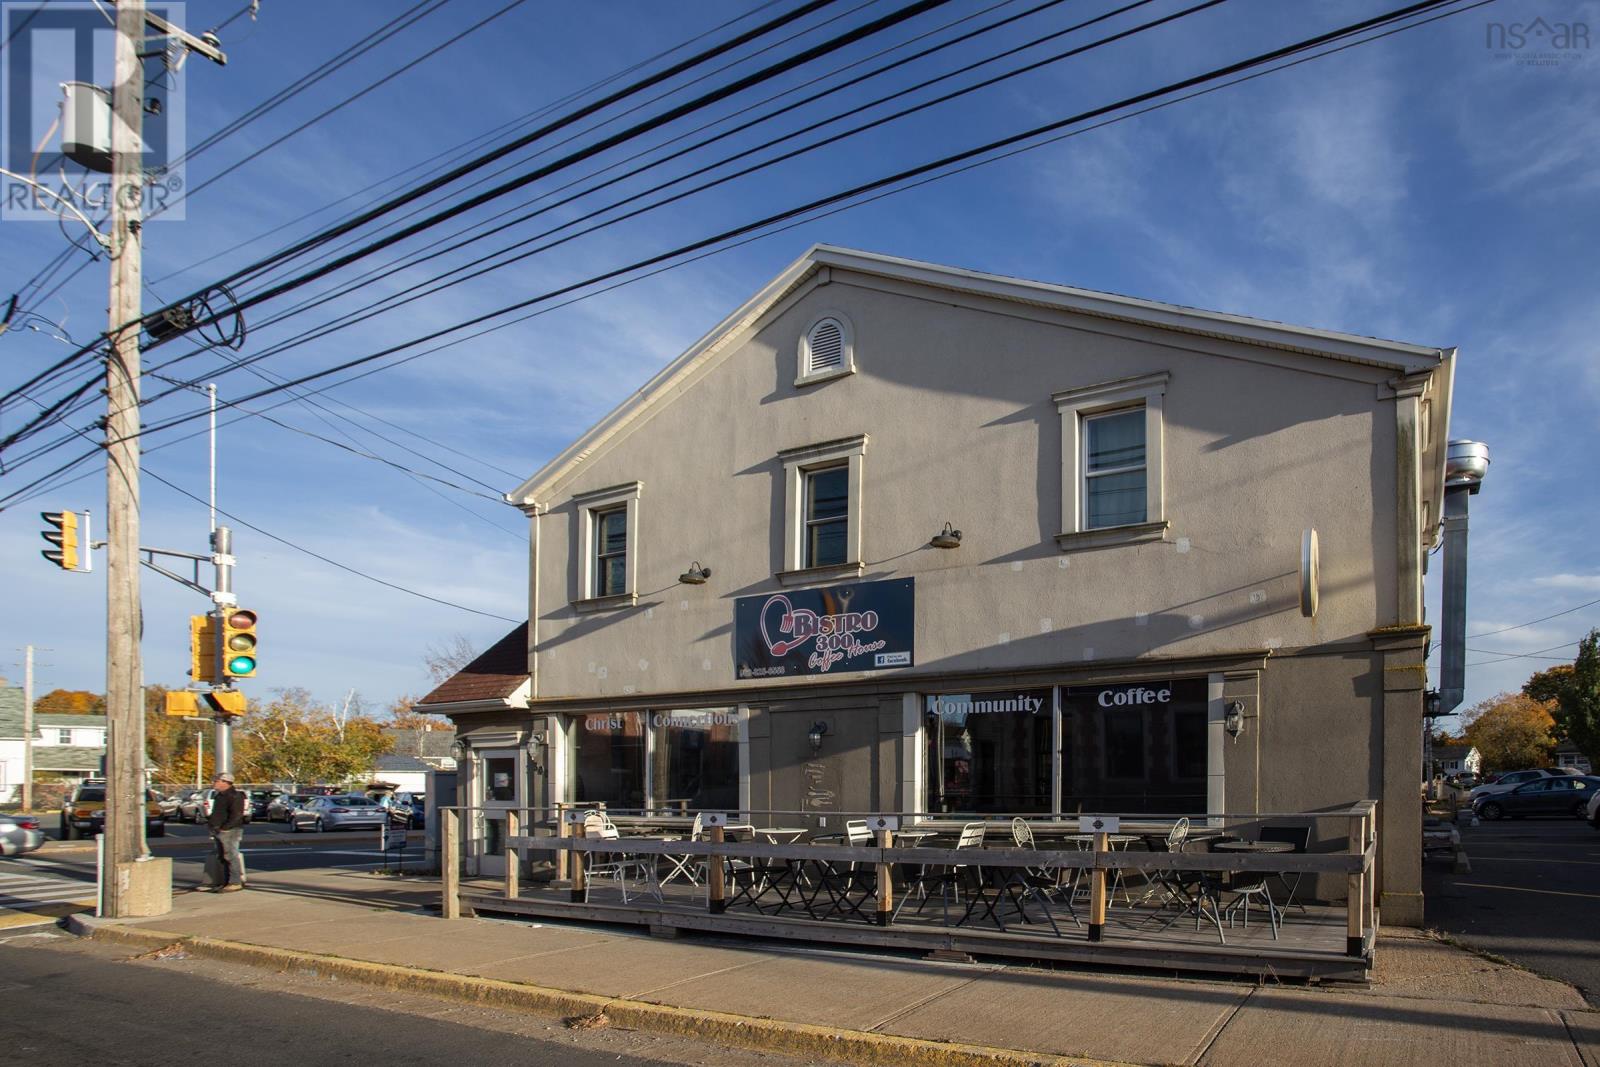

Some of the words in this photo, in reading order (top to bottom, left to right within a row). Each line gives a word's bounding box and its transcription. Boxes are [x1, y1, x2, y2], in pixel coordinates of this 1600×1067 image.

[816, 633, 855, 651] 300
[808, 649, 844, 672] Coffee
[847, 640, 886, 658] House
[932, 694, 1043, 715] Community
[1098, 687, 1171, 707] Coffee
[585, 717, 623, 731] Christ
